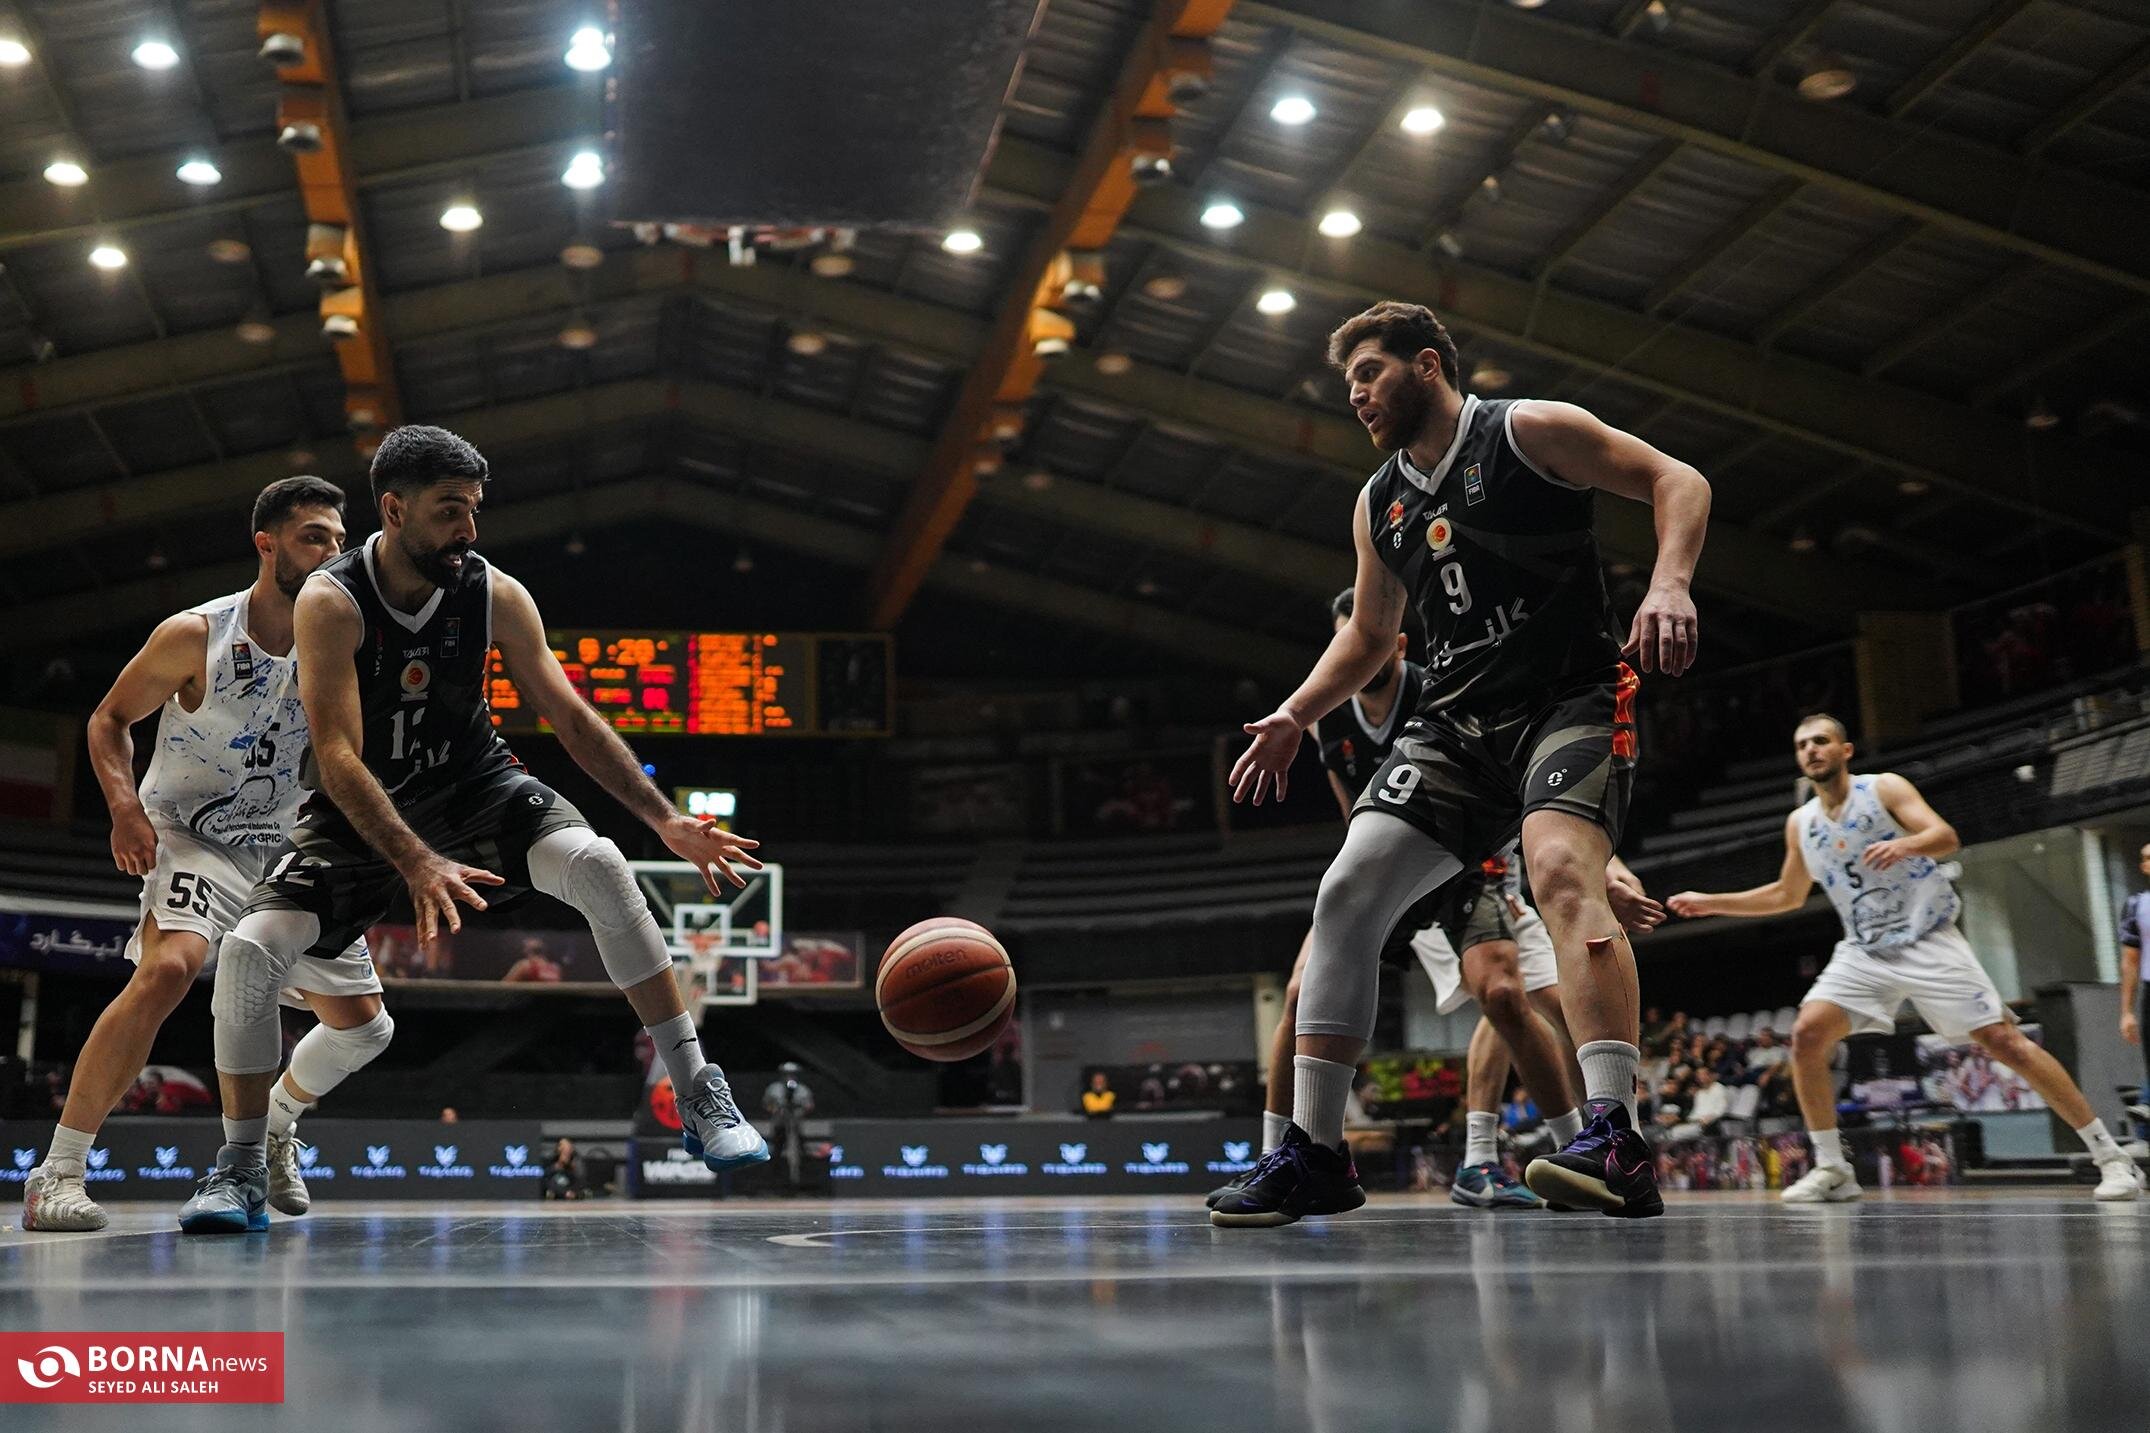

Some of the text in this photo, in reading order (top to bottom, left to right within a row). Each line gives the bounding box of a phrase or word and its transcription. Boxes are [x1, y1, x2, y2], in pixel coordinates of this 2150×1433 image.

[1440, 561, 1472, 615] 9
[1378, 763, 1422, 805] 9
[264, 851, 333, 888] 12
[1844, 859, 1863, 889] 5
[166, 871, 213, 919] 55
[905, 947, 967, 979] molten
